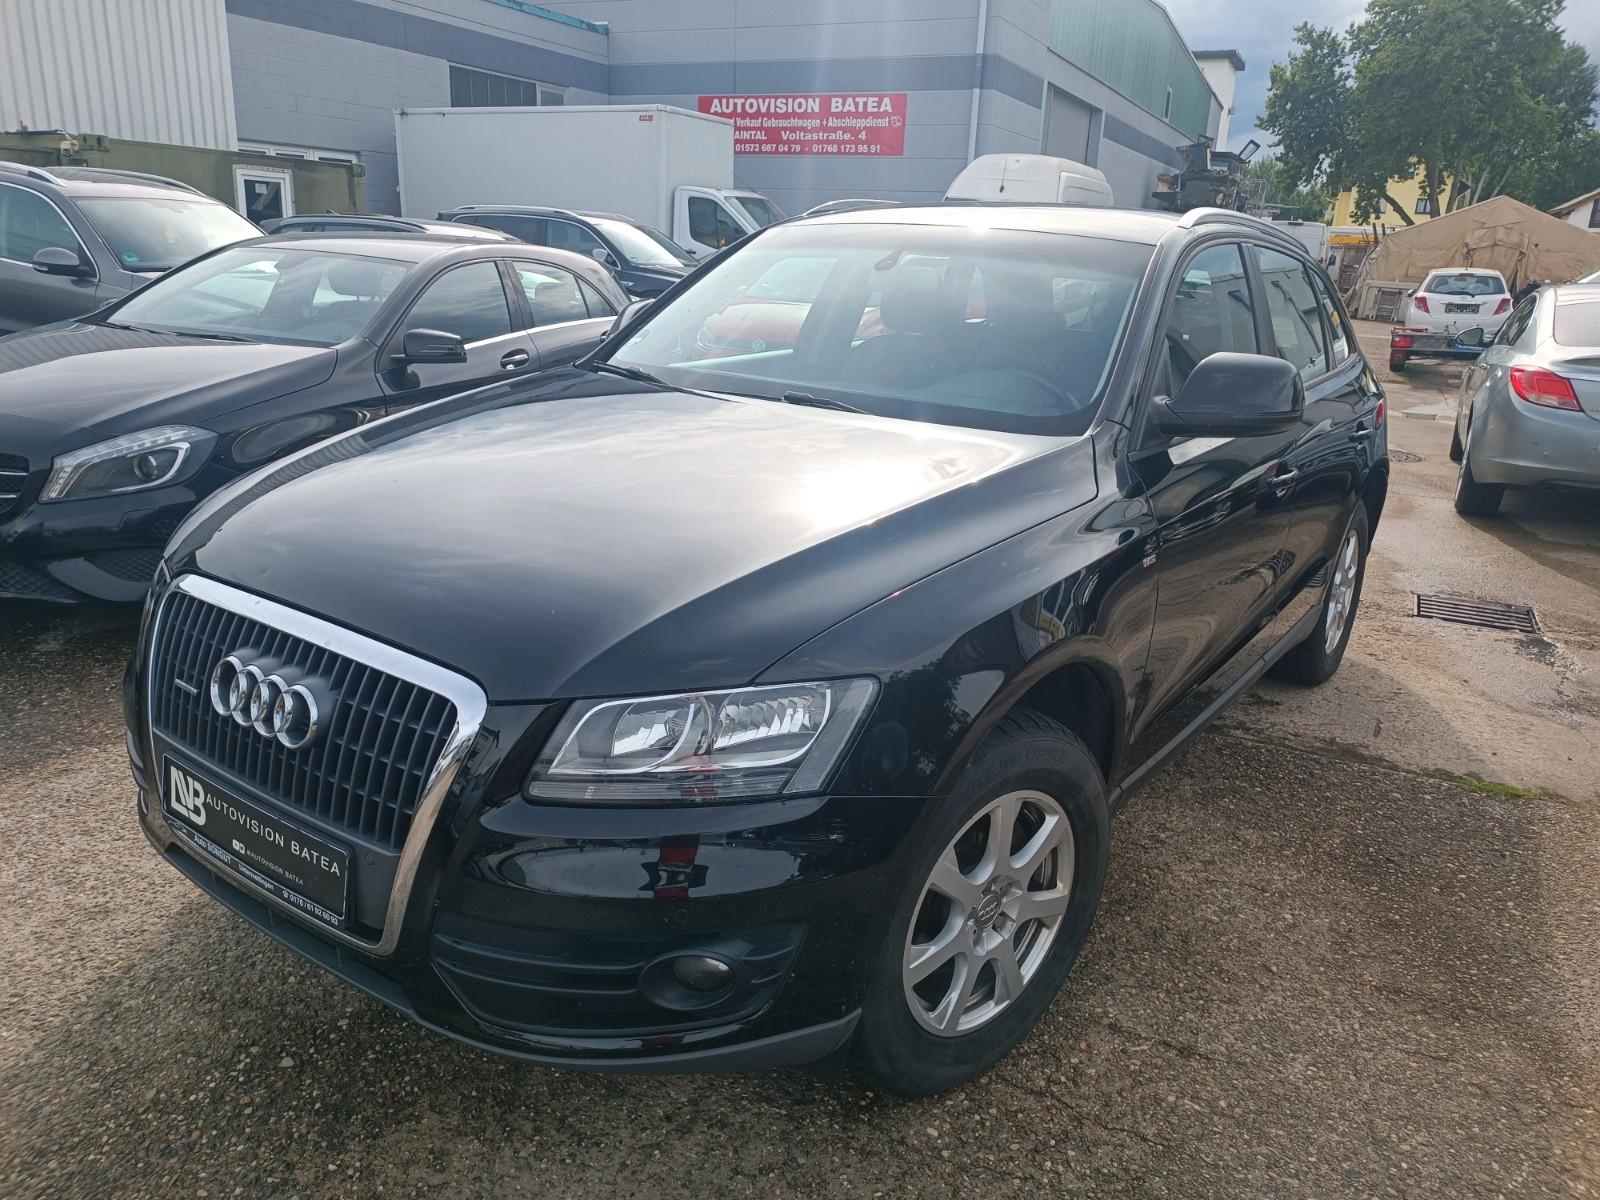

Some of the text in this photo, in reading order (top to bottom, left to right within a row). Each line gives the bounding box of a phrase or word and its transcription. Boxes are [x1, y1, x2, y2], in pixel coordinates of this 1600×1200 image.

[709, 96, 893, 114] AUTOVISION BATEA
[736, 116, 761, 128] Verkauf
[762, 116, 821, 130] Gebrauchtwagen
[827, 116, 889, 130] Abschleppdienst
[734, 130, 768, 140] AINTAL
[858, 130, 867, 140] 4
[735, 143, 760, 152] 01573
[206, 793, 341, 877] AUTOVISION BATEA
